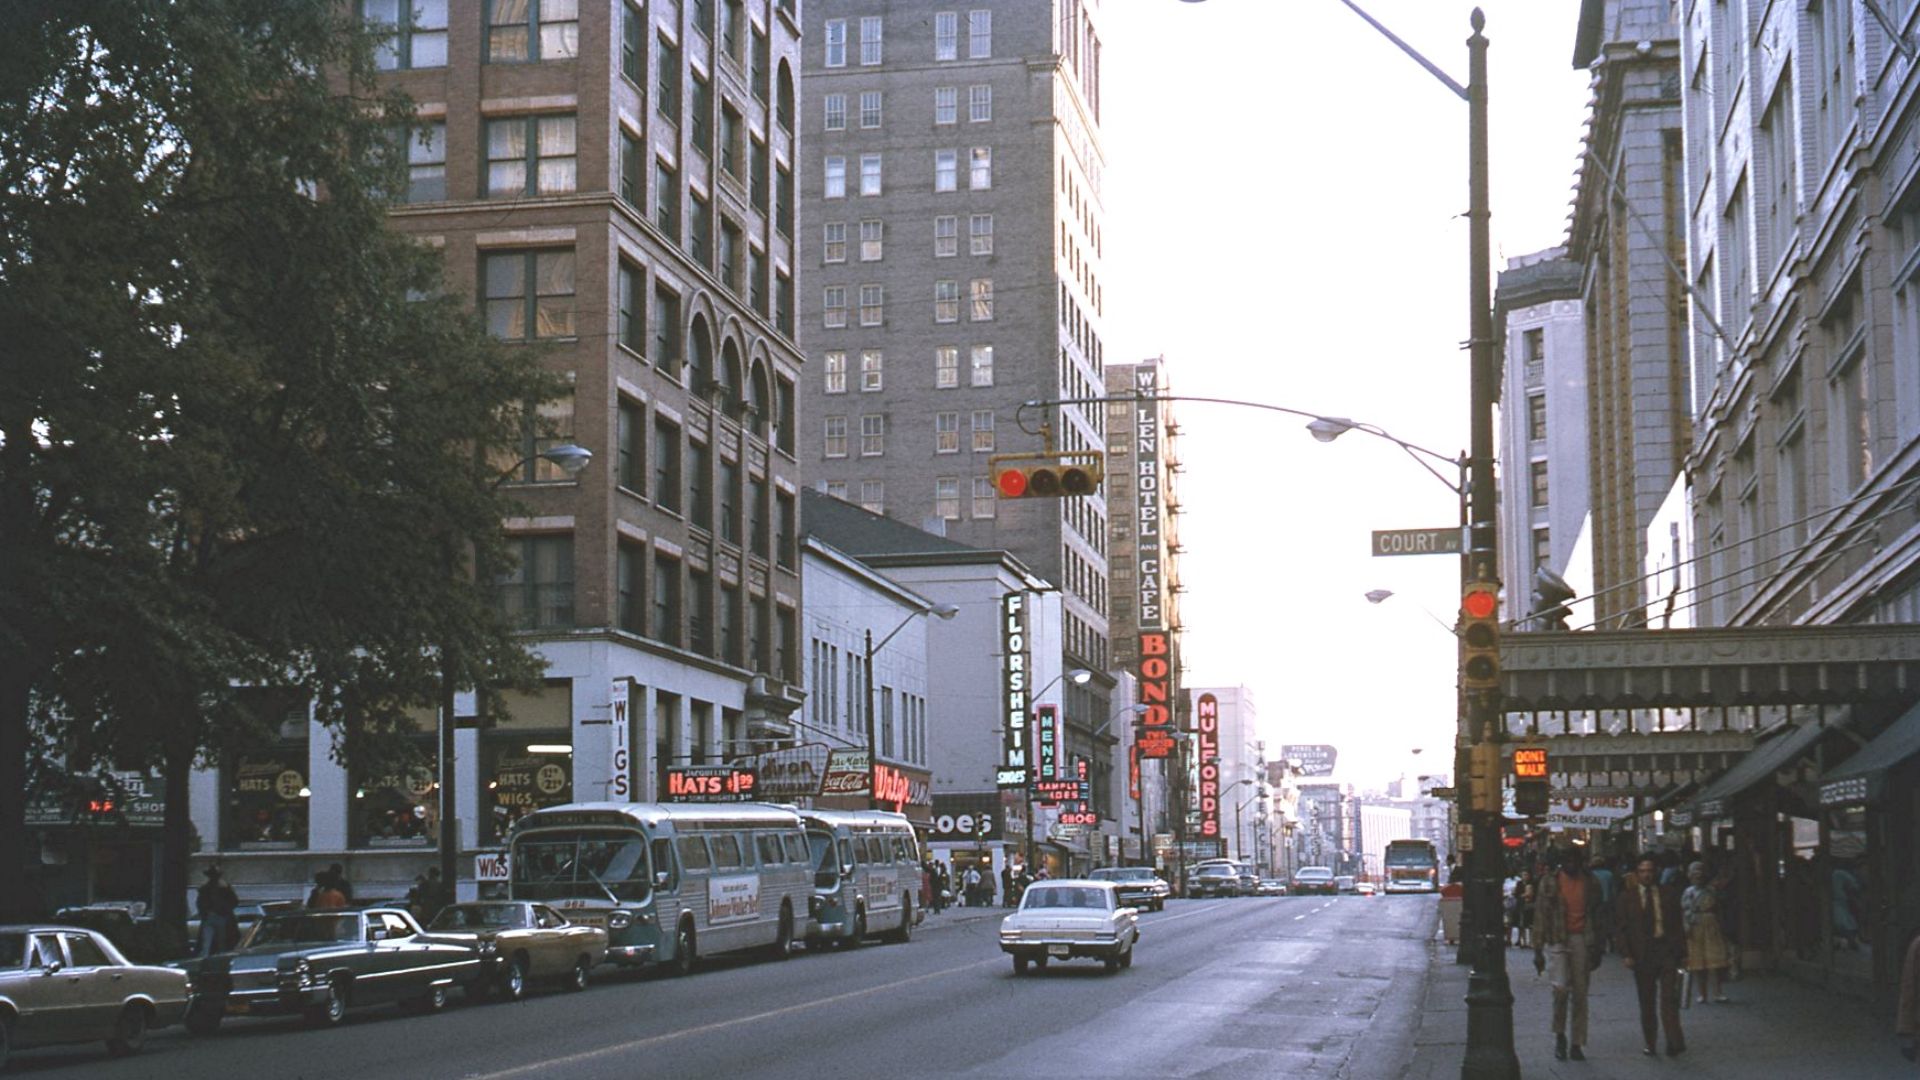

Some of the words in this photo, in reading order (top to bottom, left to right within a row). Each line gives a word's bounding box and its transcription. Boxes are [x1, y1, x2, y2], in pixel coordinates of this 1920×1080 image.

[1138, 408, 1156, 453] LEN
[1139, 460, 1158, 536] HOTEL
[1380, 532, 1438, 552] COURT
[1141, 559, 1159, 620] CAFE
[1008, 596, 1025, 767] FLORSHEIM
[1141, 634, 1168, 725] BOND
[614, 700, 628, 796] WIGS
[1041, 715, 1054, 777] MEN'S
[1515, 750, 1546, 763] DONT
[499, 773, 530, 785] HATS
[669, 772, 722, 794] HATS
[1200, 702, 1217, 836] MULFORD'S
[1515, 763, 1546, 776] WALK
[498, 792, 533, 805] WIGS
[1037, 782, 1079, 791] SAMPLE
[478, 857, 508, 878] WIGS
